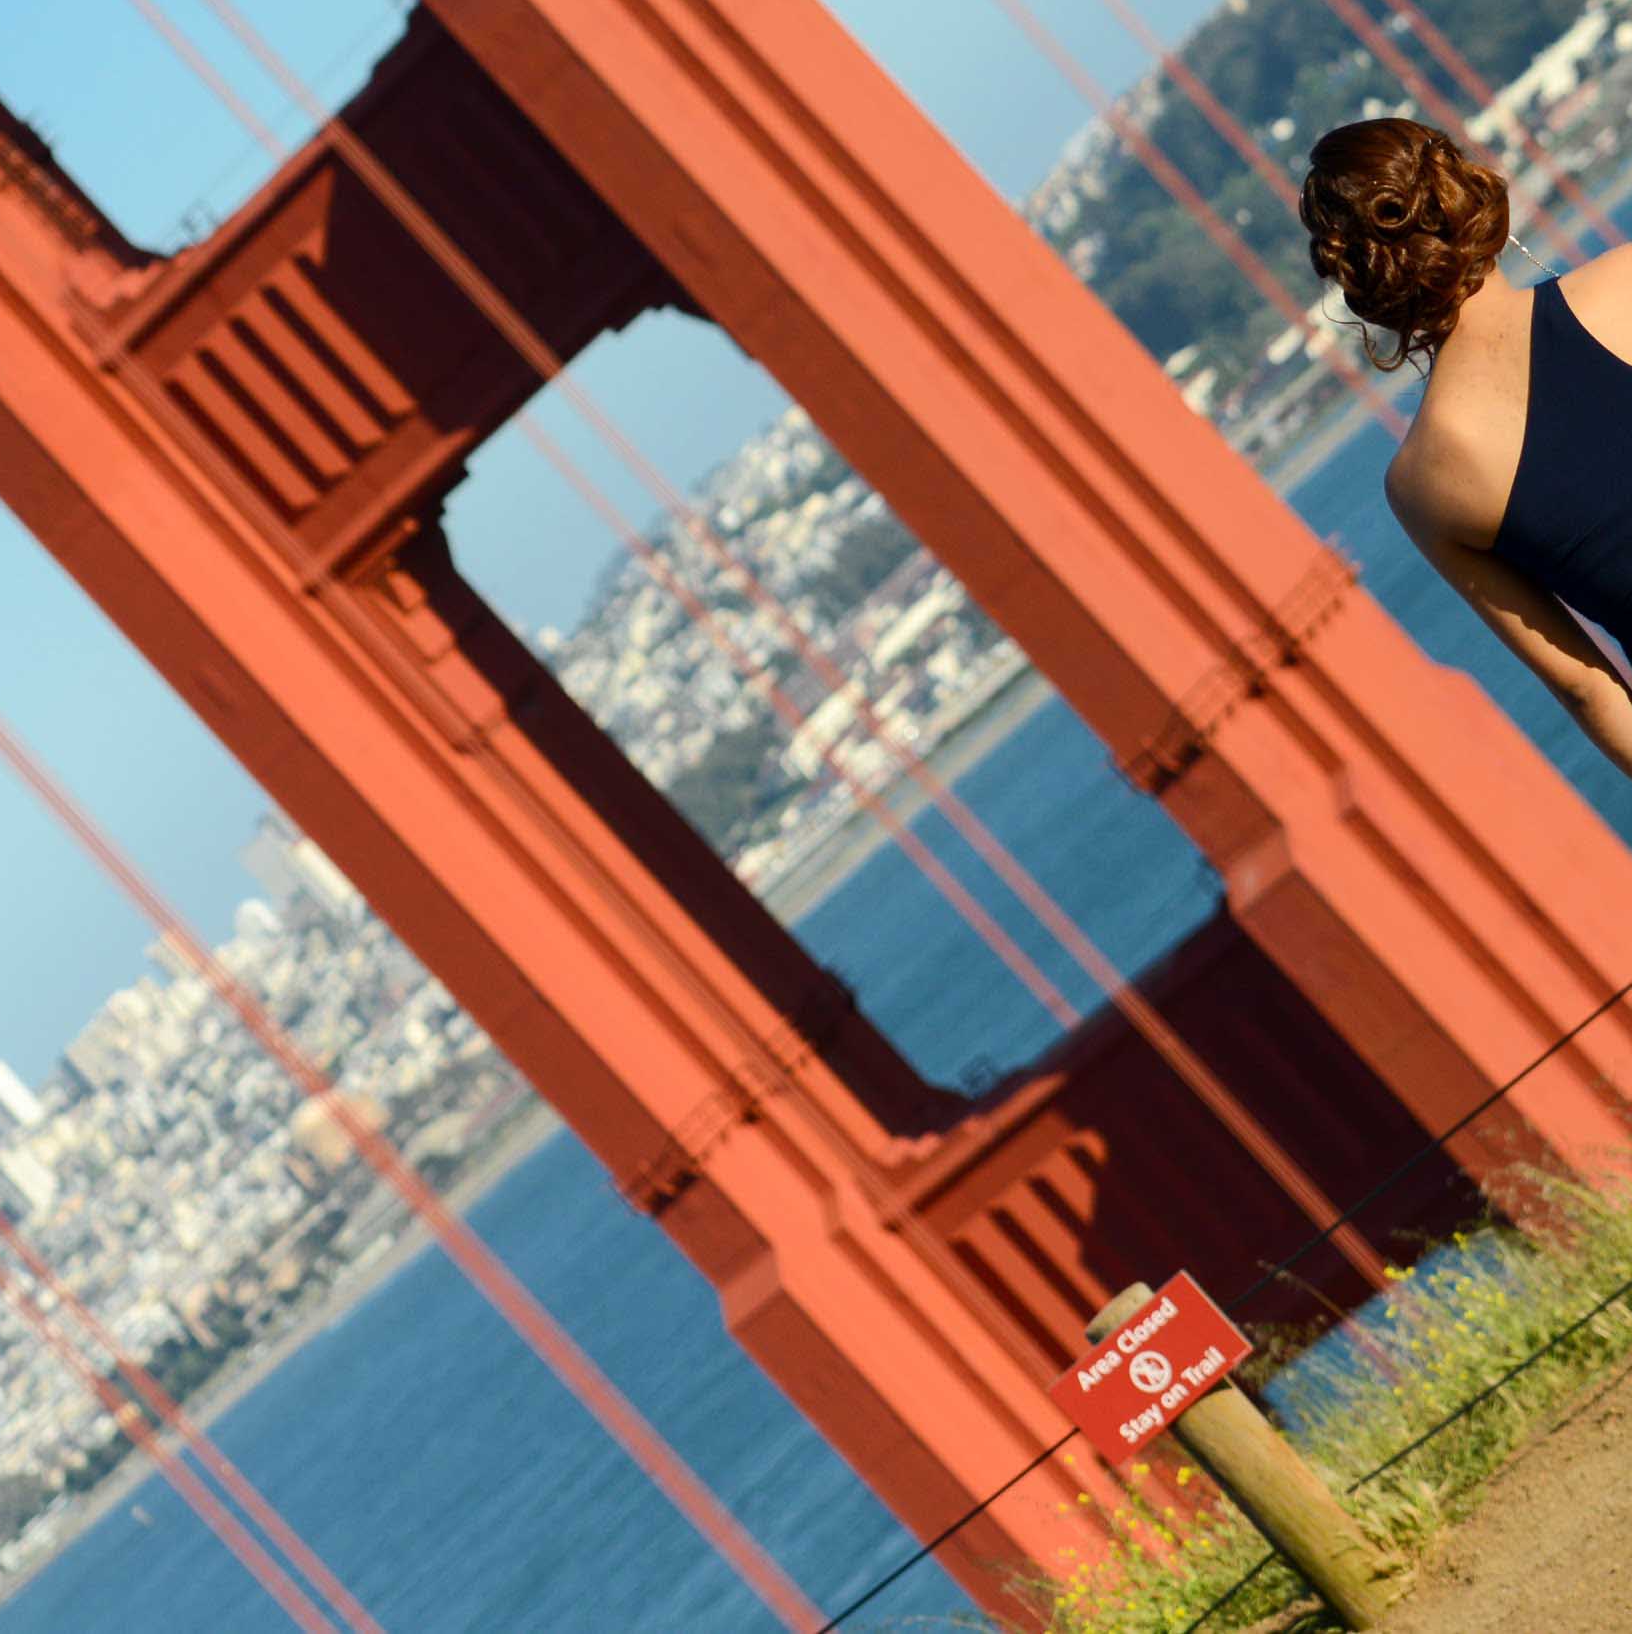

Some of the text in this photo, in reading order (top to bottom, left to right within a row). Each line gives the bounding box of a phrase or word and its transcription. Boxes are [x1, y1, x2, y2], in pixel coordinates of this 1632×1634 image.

[1077, 1296, 1178, 1391] Area Closed
[1119, 1346, 1226, 1443] Stay on Trail
